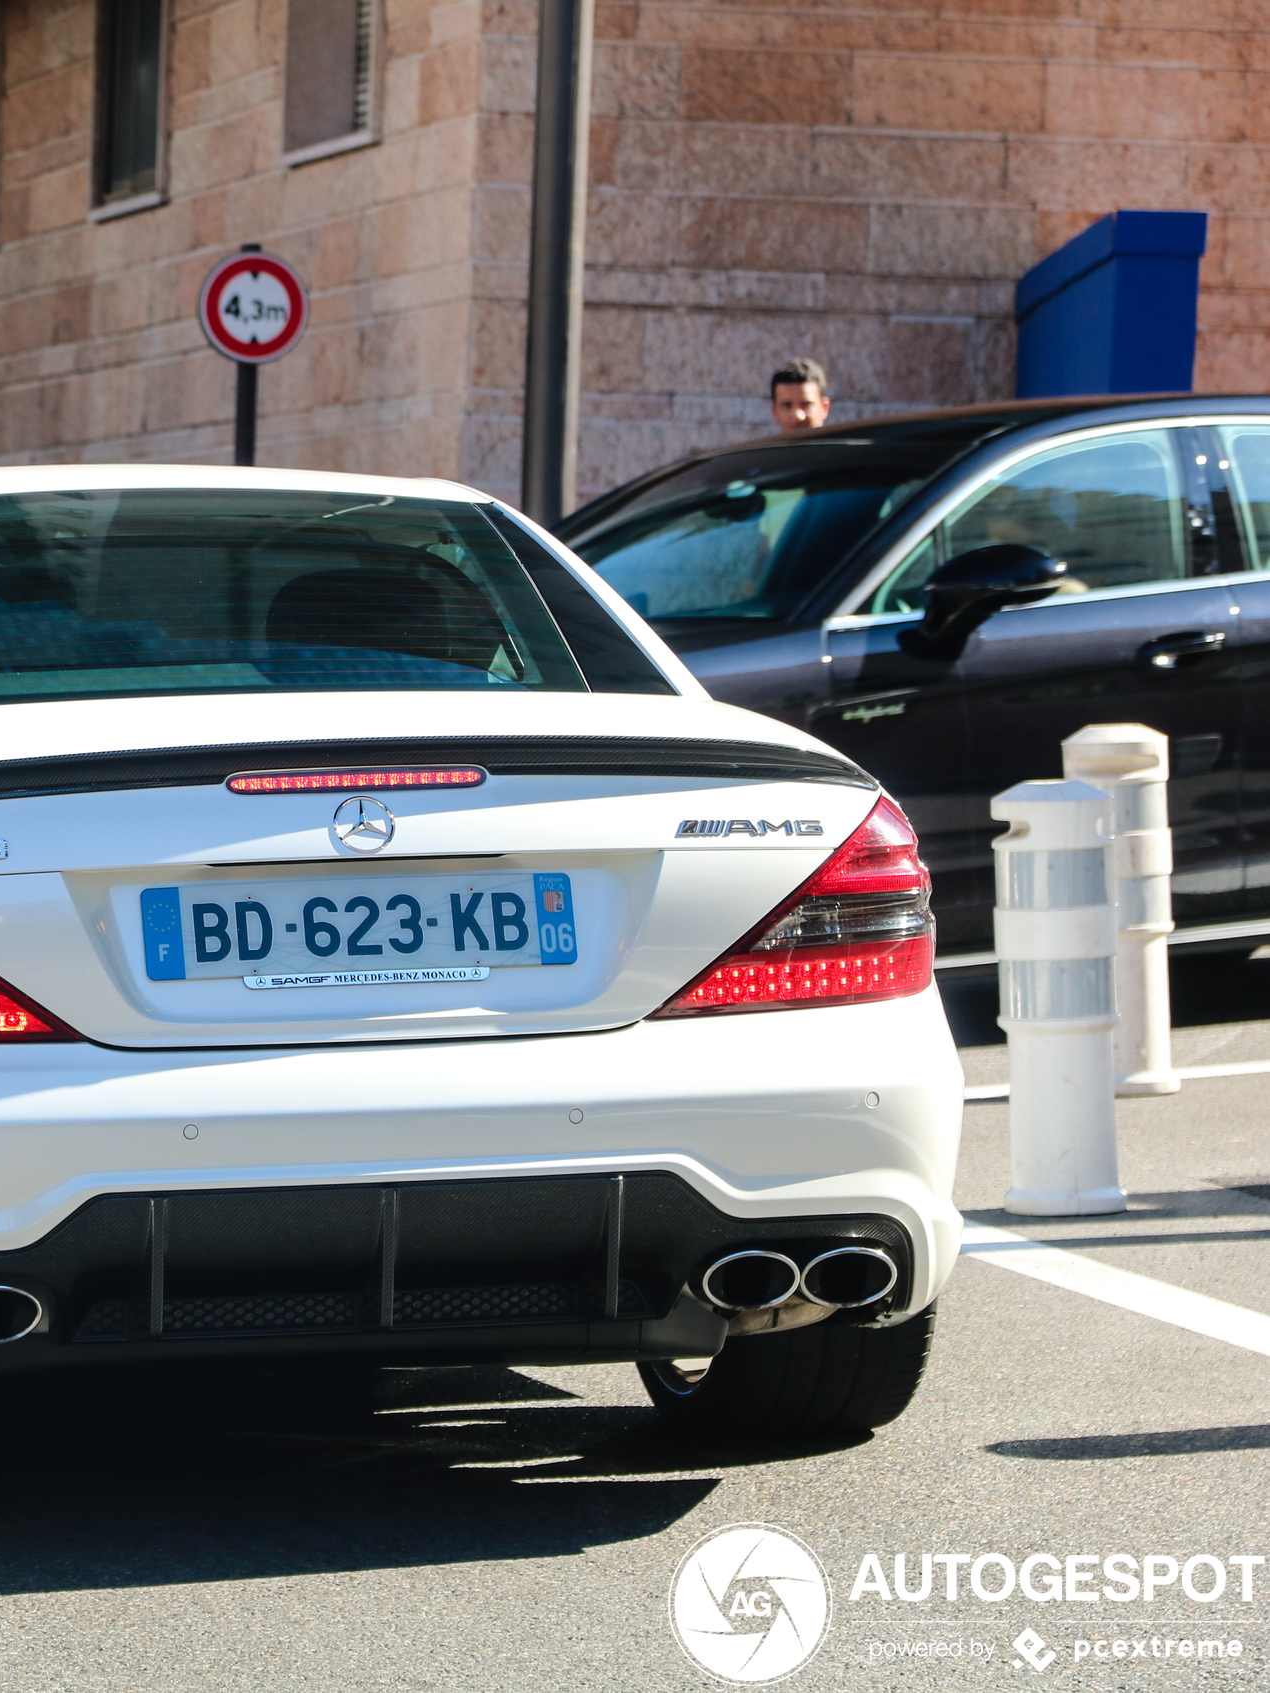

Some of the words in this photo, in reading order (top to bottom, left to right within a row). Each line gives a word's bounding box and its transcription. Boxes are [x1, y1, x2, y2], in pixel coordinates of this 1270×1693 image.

[539, 876, 563, 884] Région
[539, 883, 565, 891] PACA
[541, 923, 574, 953] 06
[158, 944, 169, 962] F
[334, 971, 419, 983] MERCEDES-BENZ
[422, 970, 467, 979] MONACO
